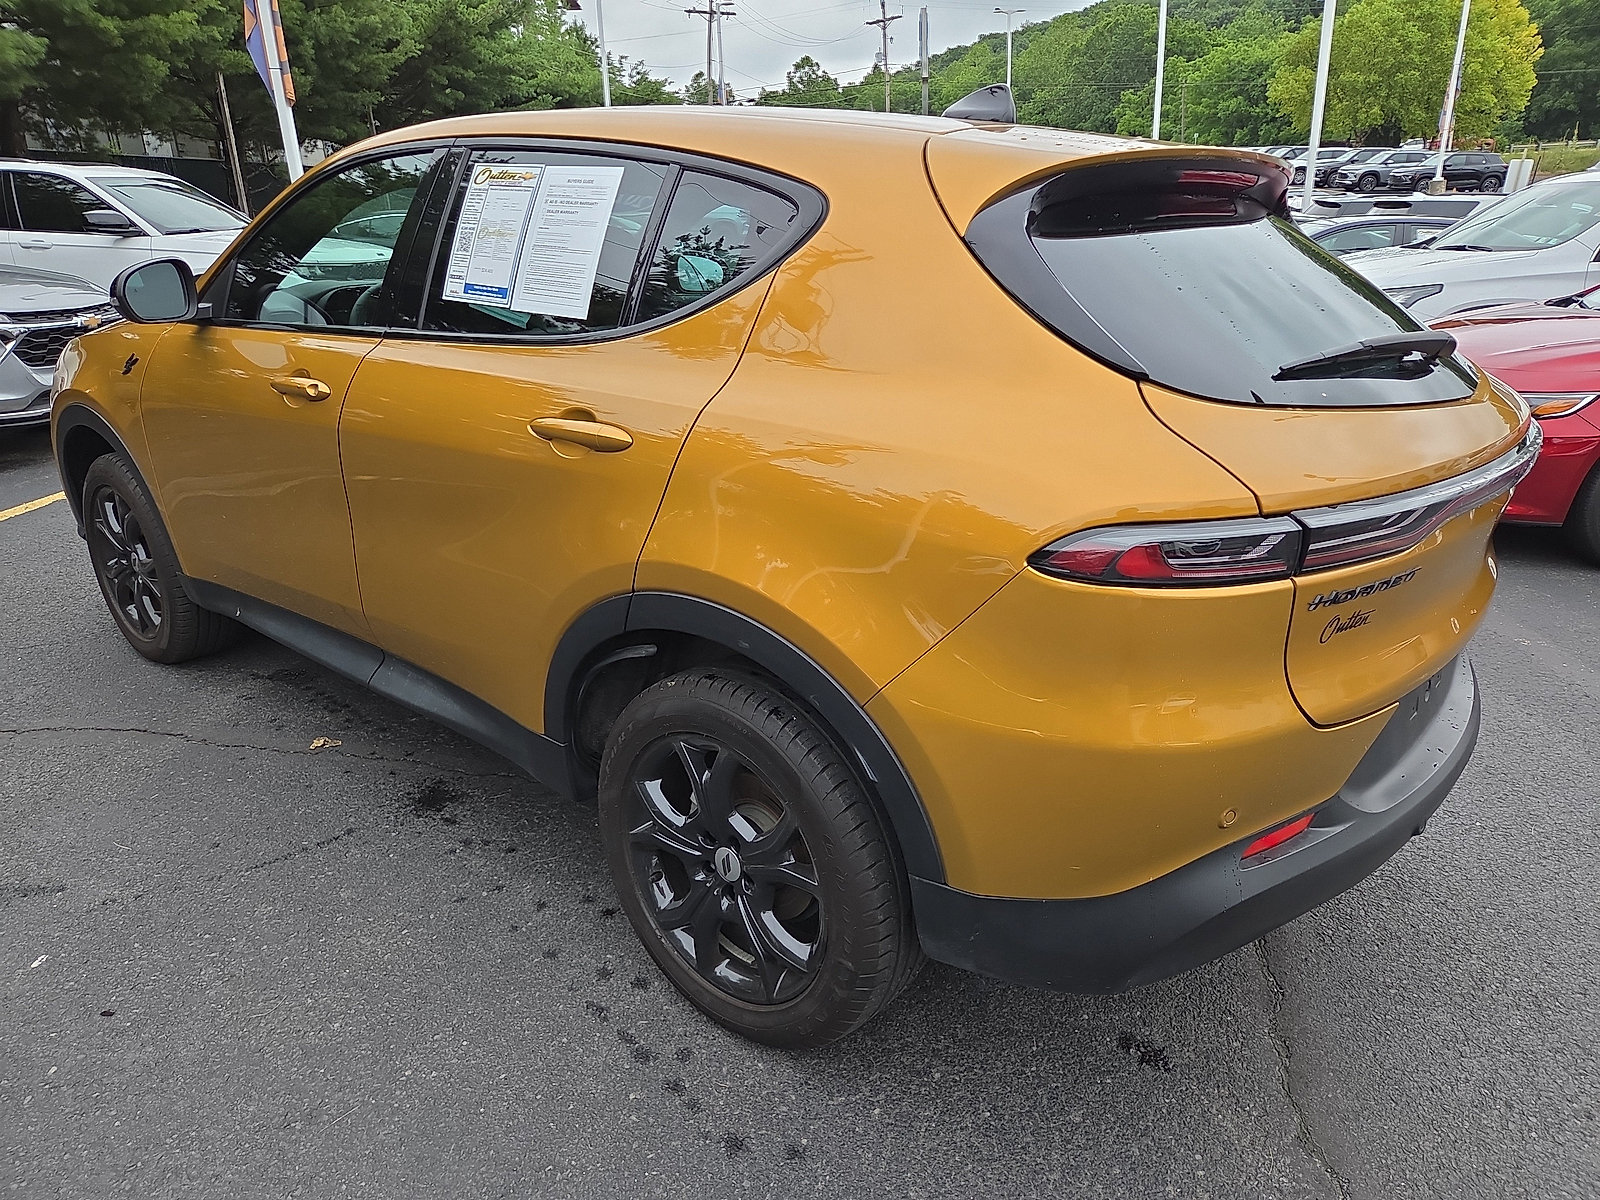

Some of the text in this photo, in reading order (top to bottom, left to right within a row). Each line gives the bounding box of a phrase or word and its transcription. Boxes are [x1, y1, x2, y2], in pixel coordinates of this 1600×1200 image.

[474, 168, 521, 185] Outten
[1307, 565, 1422, 611] HORNET
[1319, 609, 1376, 644] Outten
